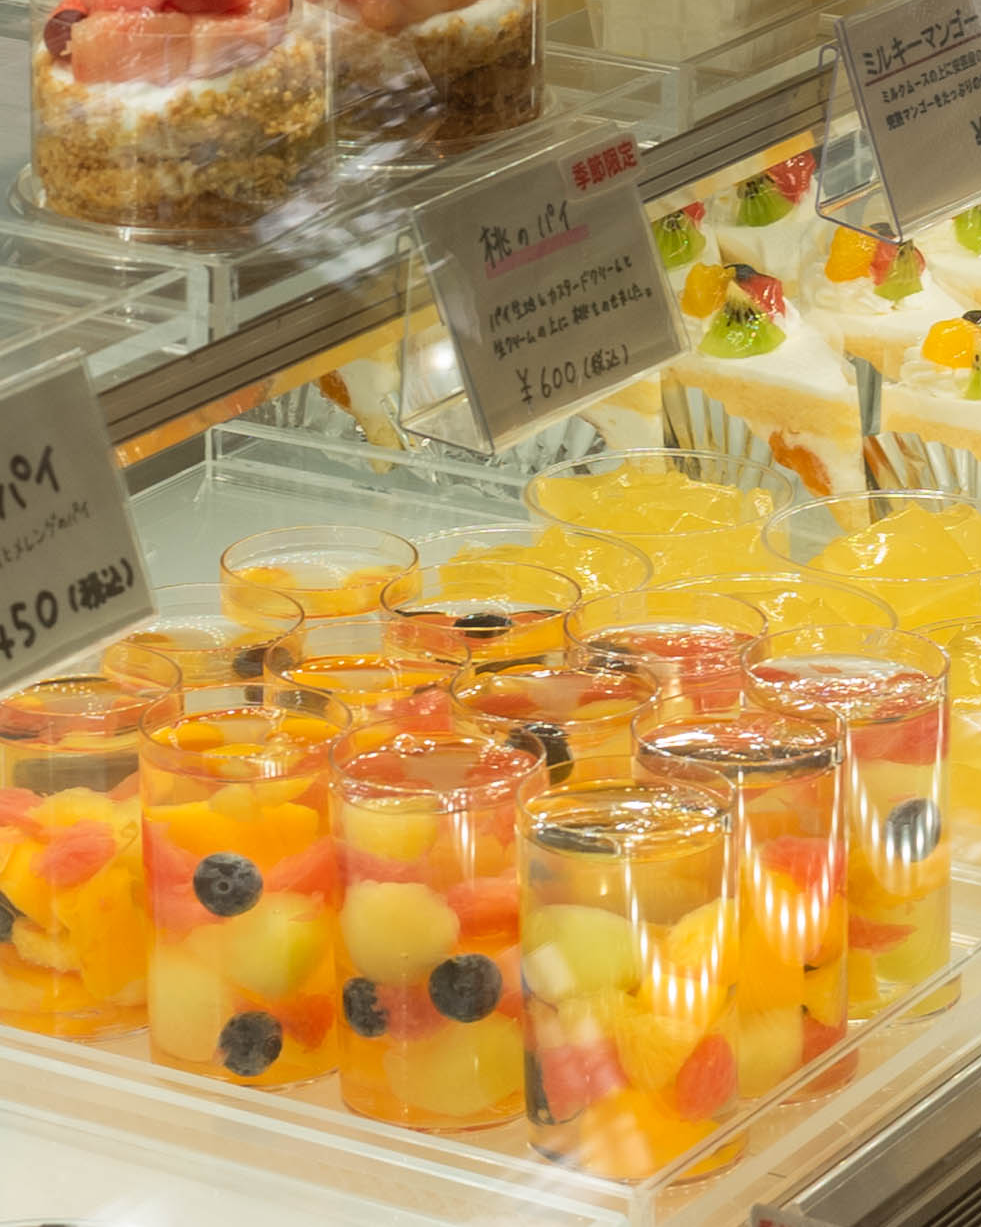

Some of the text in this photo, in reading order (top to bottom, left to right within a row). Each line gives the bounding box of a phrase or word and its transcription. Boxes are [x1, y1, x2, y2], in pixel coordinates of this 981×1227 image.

[862, 8, 980, 76] ミルキーマンゴー
[570, 139, 638, 191] 季節限定
